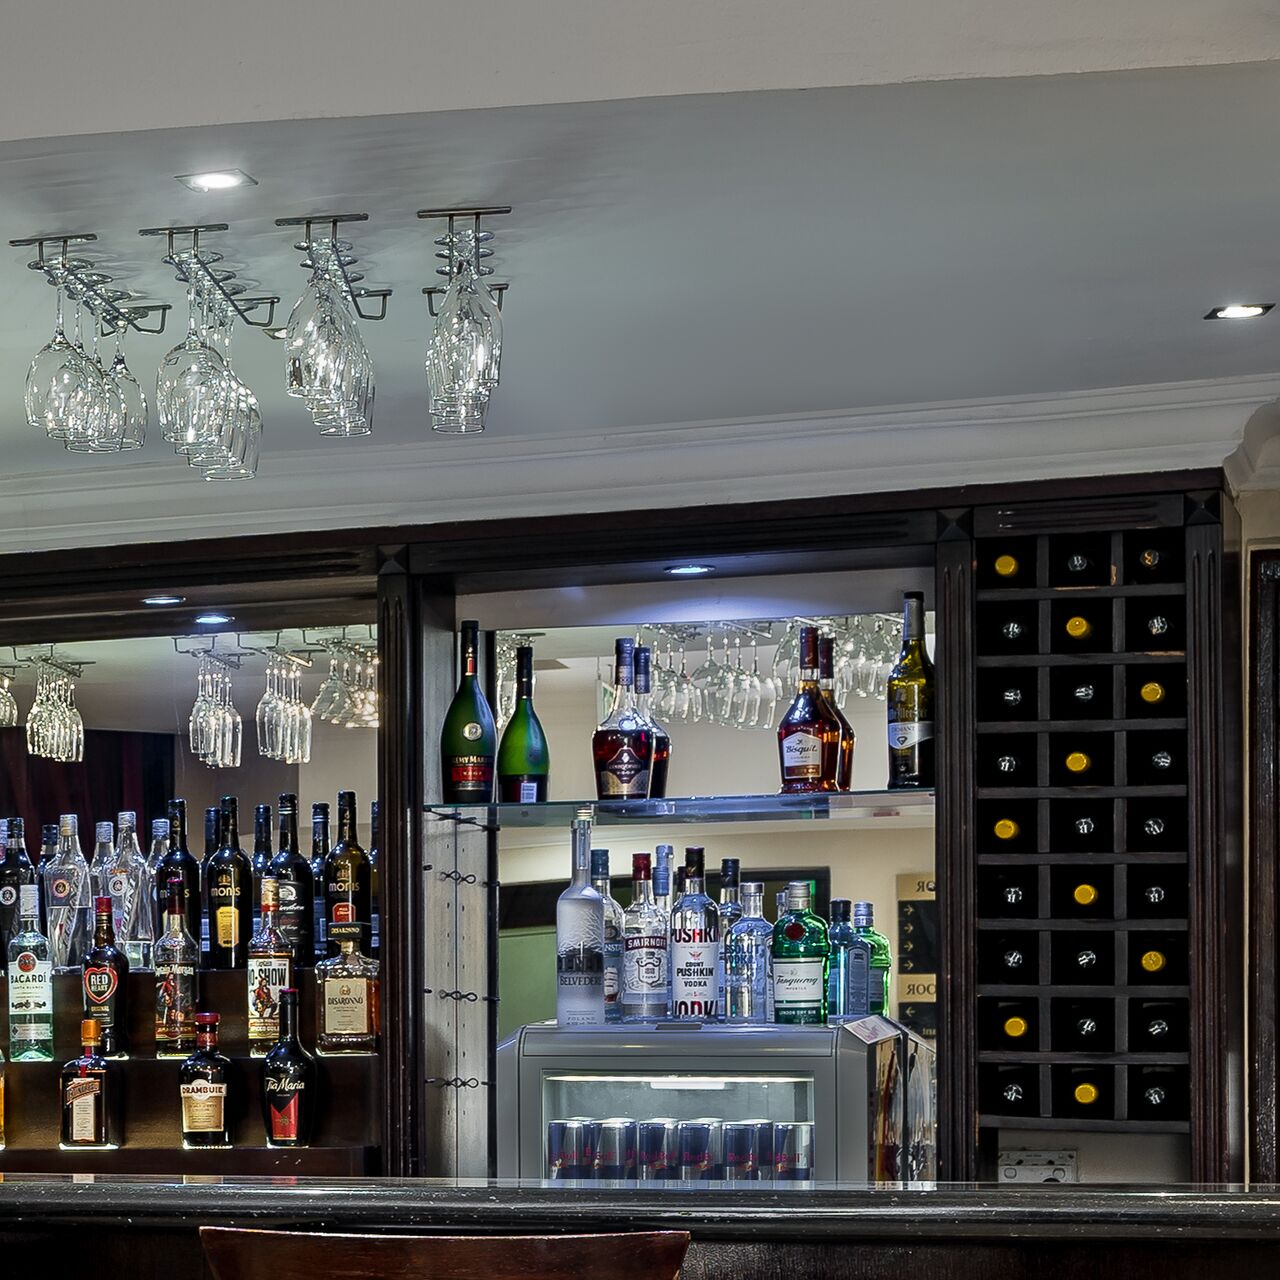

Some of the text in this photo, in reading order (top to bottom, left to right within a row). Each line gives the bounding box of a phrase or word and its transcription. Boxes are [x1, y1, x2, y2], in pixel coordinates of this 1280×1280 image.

[671, 928, 721, 943] USHKI
[11, 971, 47, 983] BACARDÍ
[676, 967, 715, 977] PUSHKIN
[90, 974, 109, 985] RED
[327, 997, 364, 1005] DISARONNO
[182, 1086, 224, 1094] DRAMBUIE
[264, 1077, 306, 1092] Tia Maria
